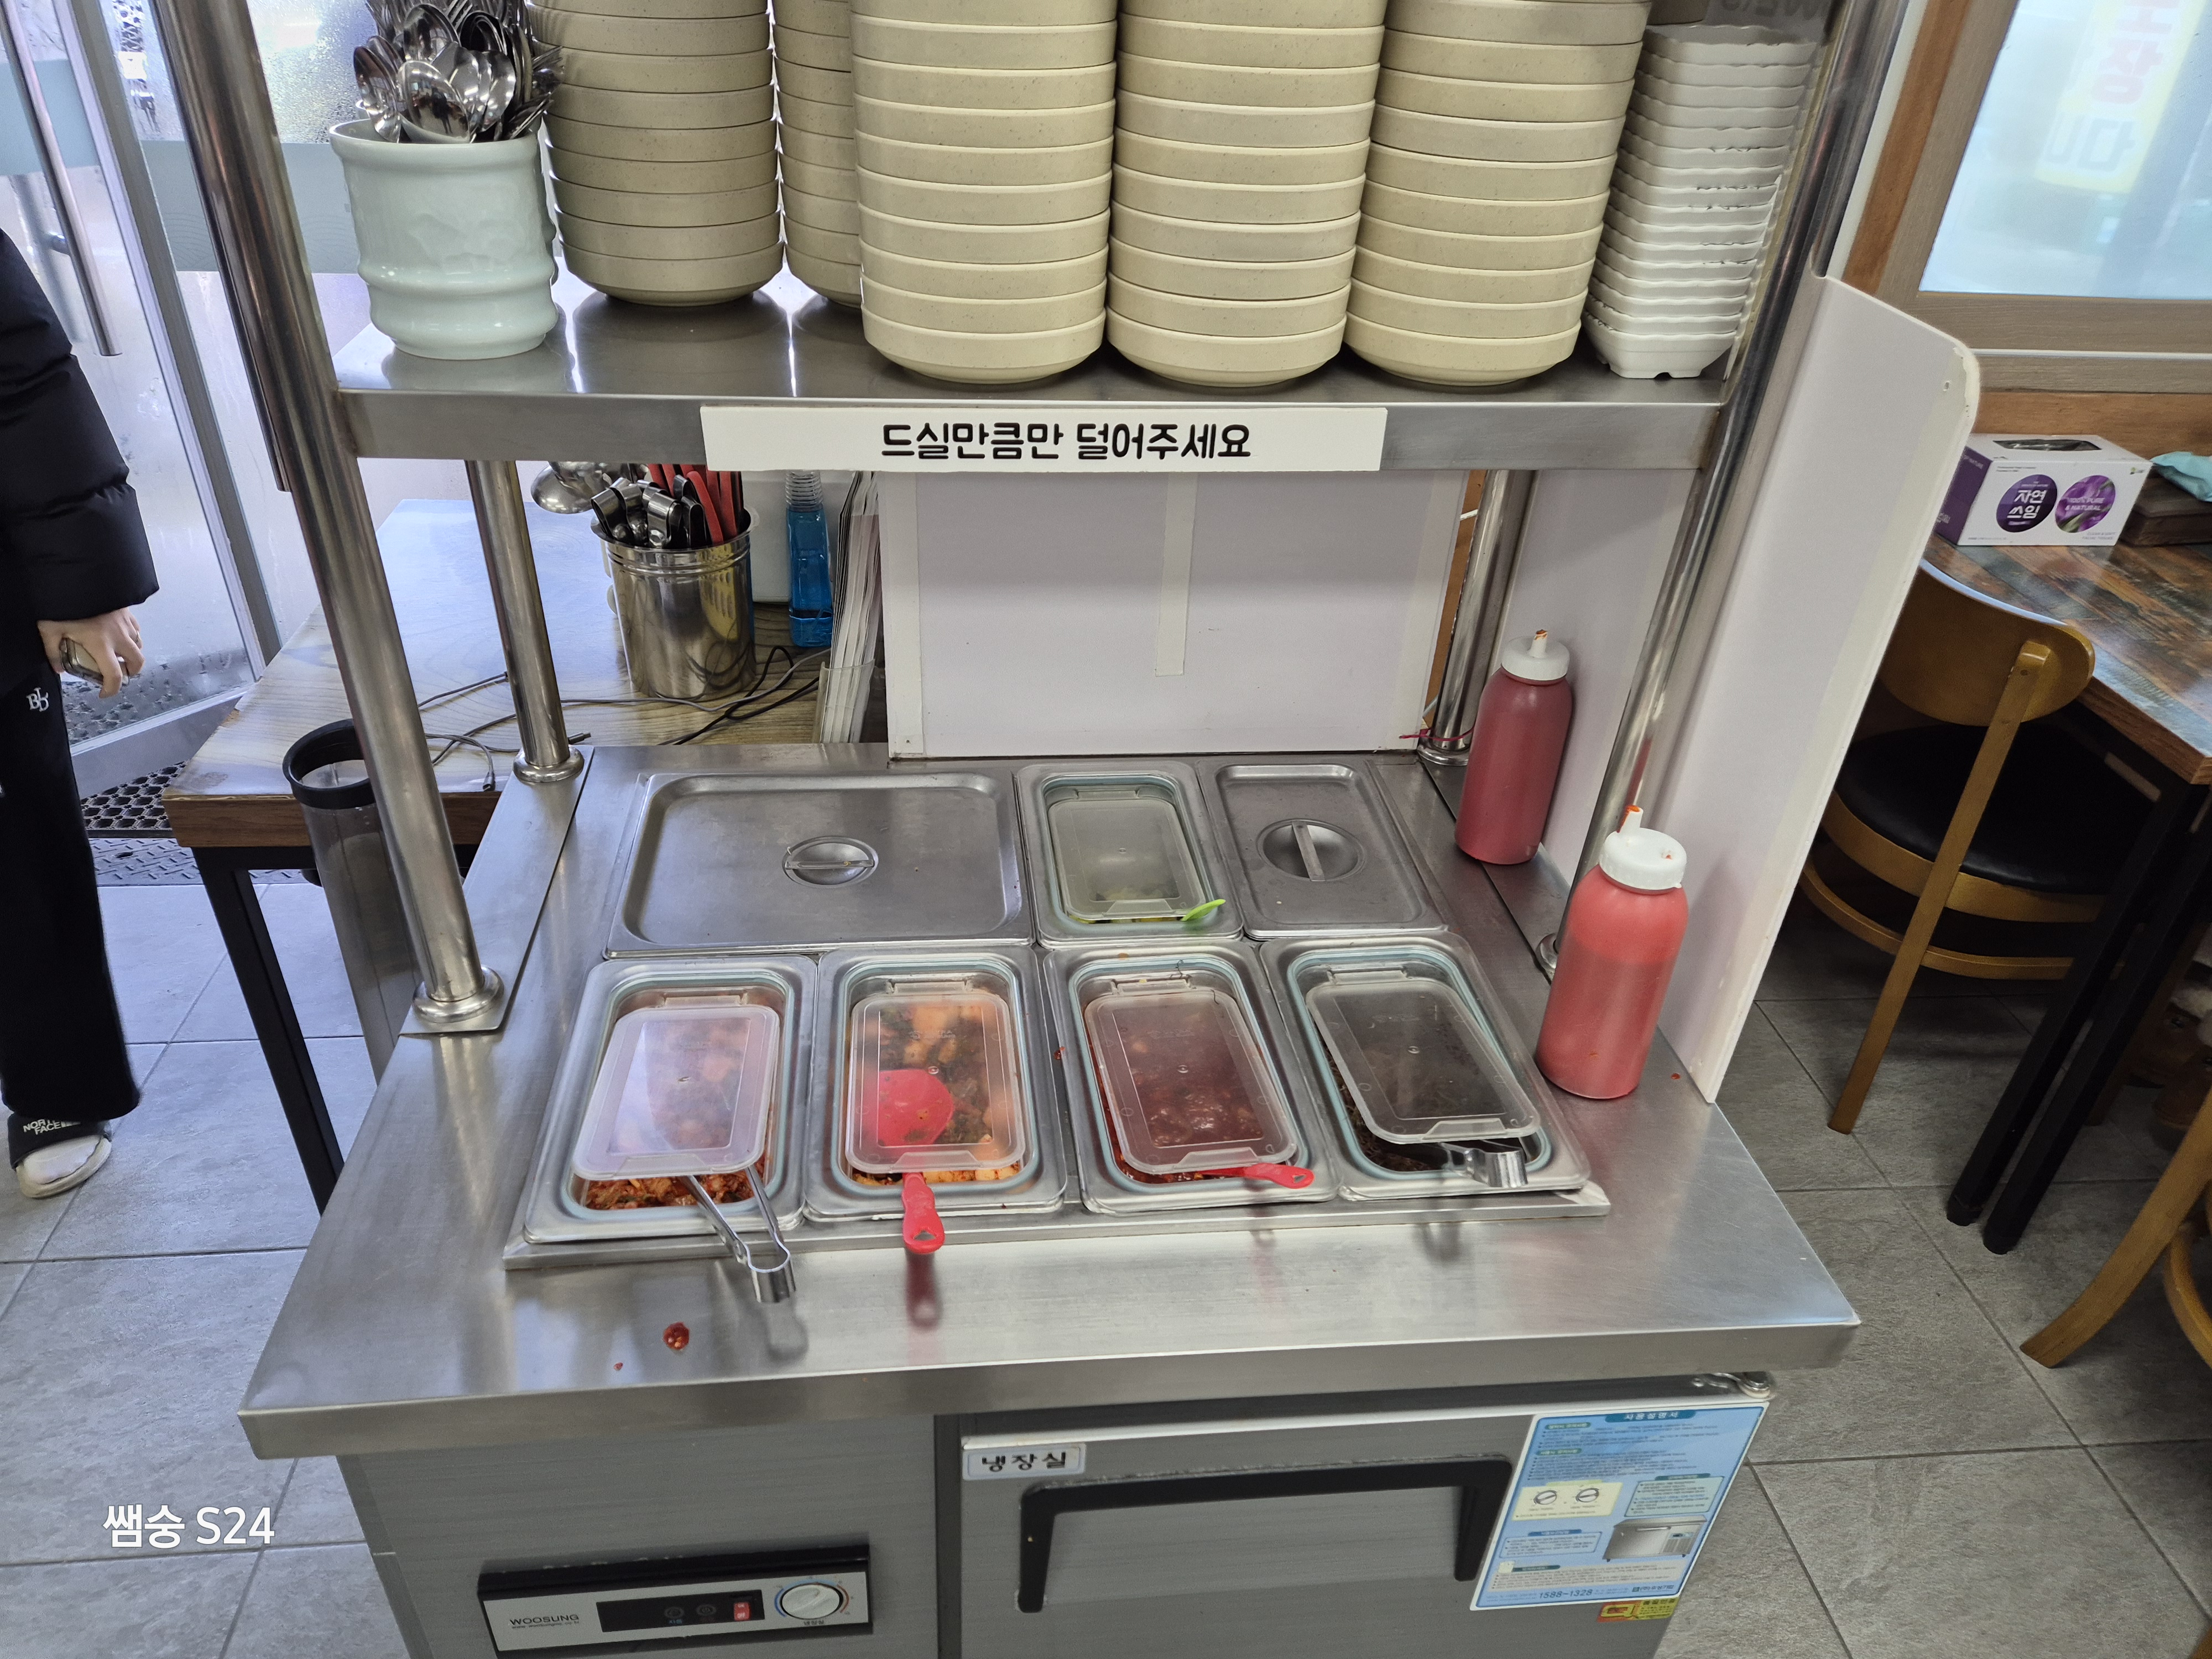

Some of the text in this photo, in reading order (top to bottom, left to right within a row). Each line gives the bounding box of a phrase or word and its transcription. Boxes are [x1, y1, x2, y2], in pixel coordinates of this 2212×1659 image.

[881, 422, 1251, 460] 드실만큼만 덜어주세요
[2013, 489, 2048, 504] 자연
[2006, 505, 2041, 519] 쓰임
[34, 1121, 62, 1135] FACE
[1624, 1411, 1679, 1420] 사용설명서
[982, 1451, 1066, 1473] 냉장실
[1538, 1588, 1593, 1599] 1588-1328
[510, 1614, 580, 1625] WOOSUNG
